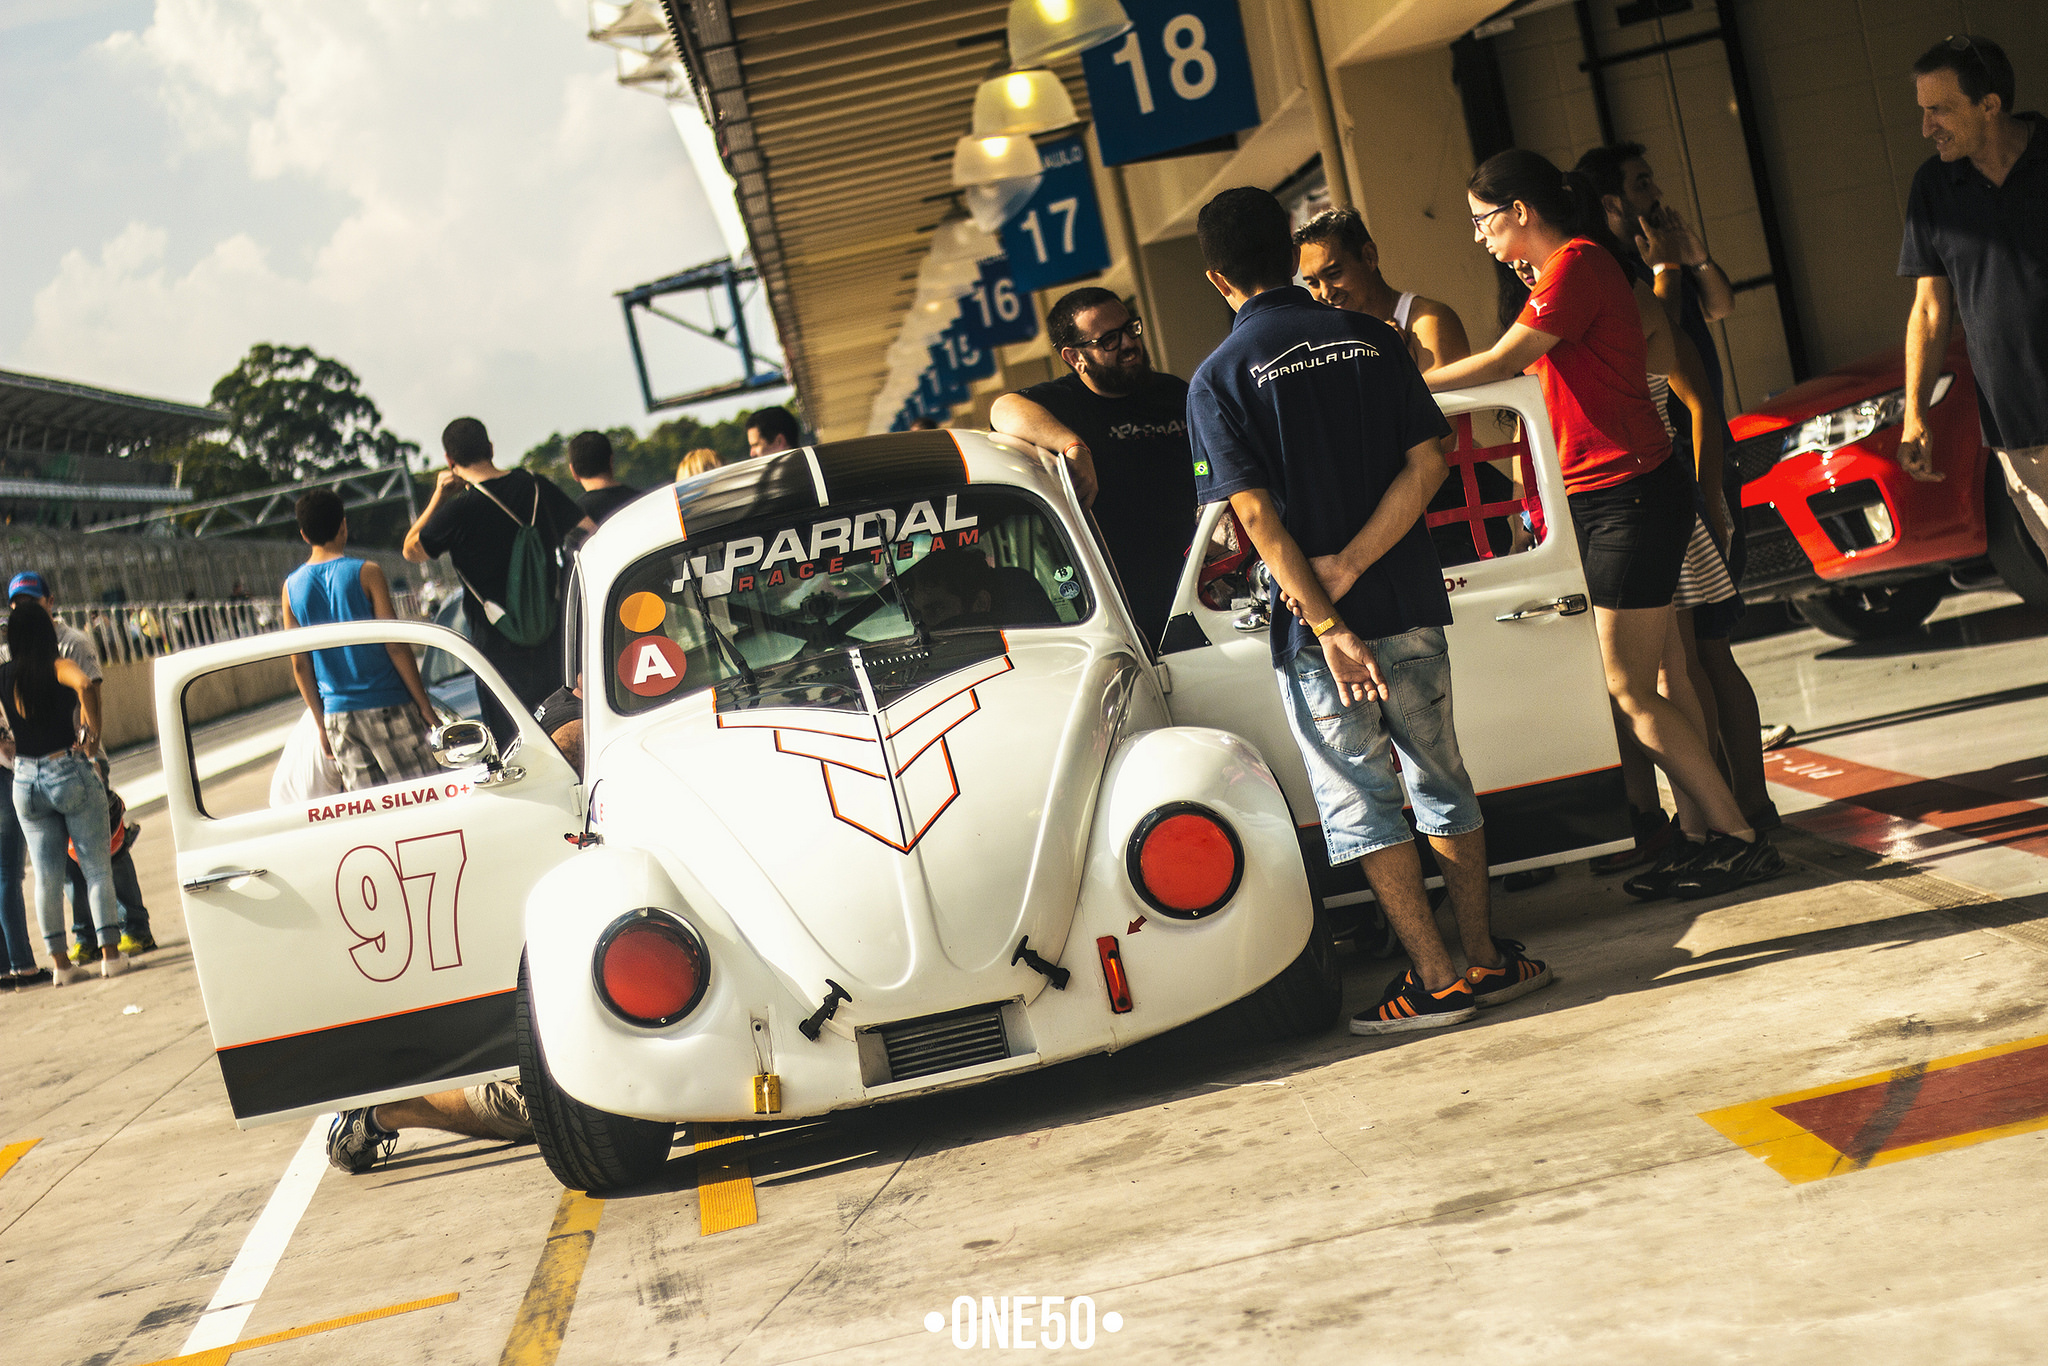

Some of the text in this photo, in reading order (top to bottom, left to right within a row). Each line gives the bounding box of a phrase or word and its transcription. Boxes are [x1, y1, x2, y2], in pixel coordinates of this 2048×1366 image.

[1112, 13, 1218, 115] 18
[1020, 197, 1077, 263] 17
[972, 278, 1020, 328] 16
[943, 334, 981, 370] 15
[1257, 353, 1338, 388] FORMULA
[722, 494, 979, 597] PARDAL
[737, 529, 980, 592] RACE TEAM
[632, 642, 677, 685] A
[308, 784, 471, 823] RAPHA SILVA O+
[335, 829, 468, 983] 97
